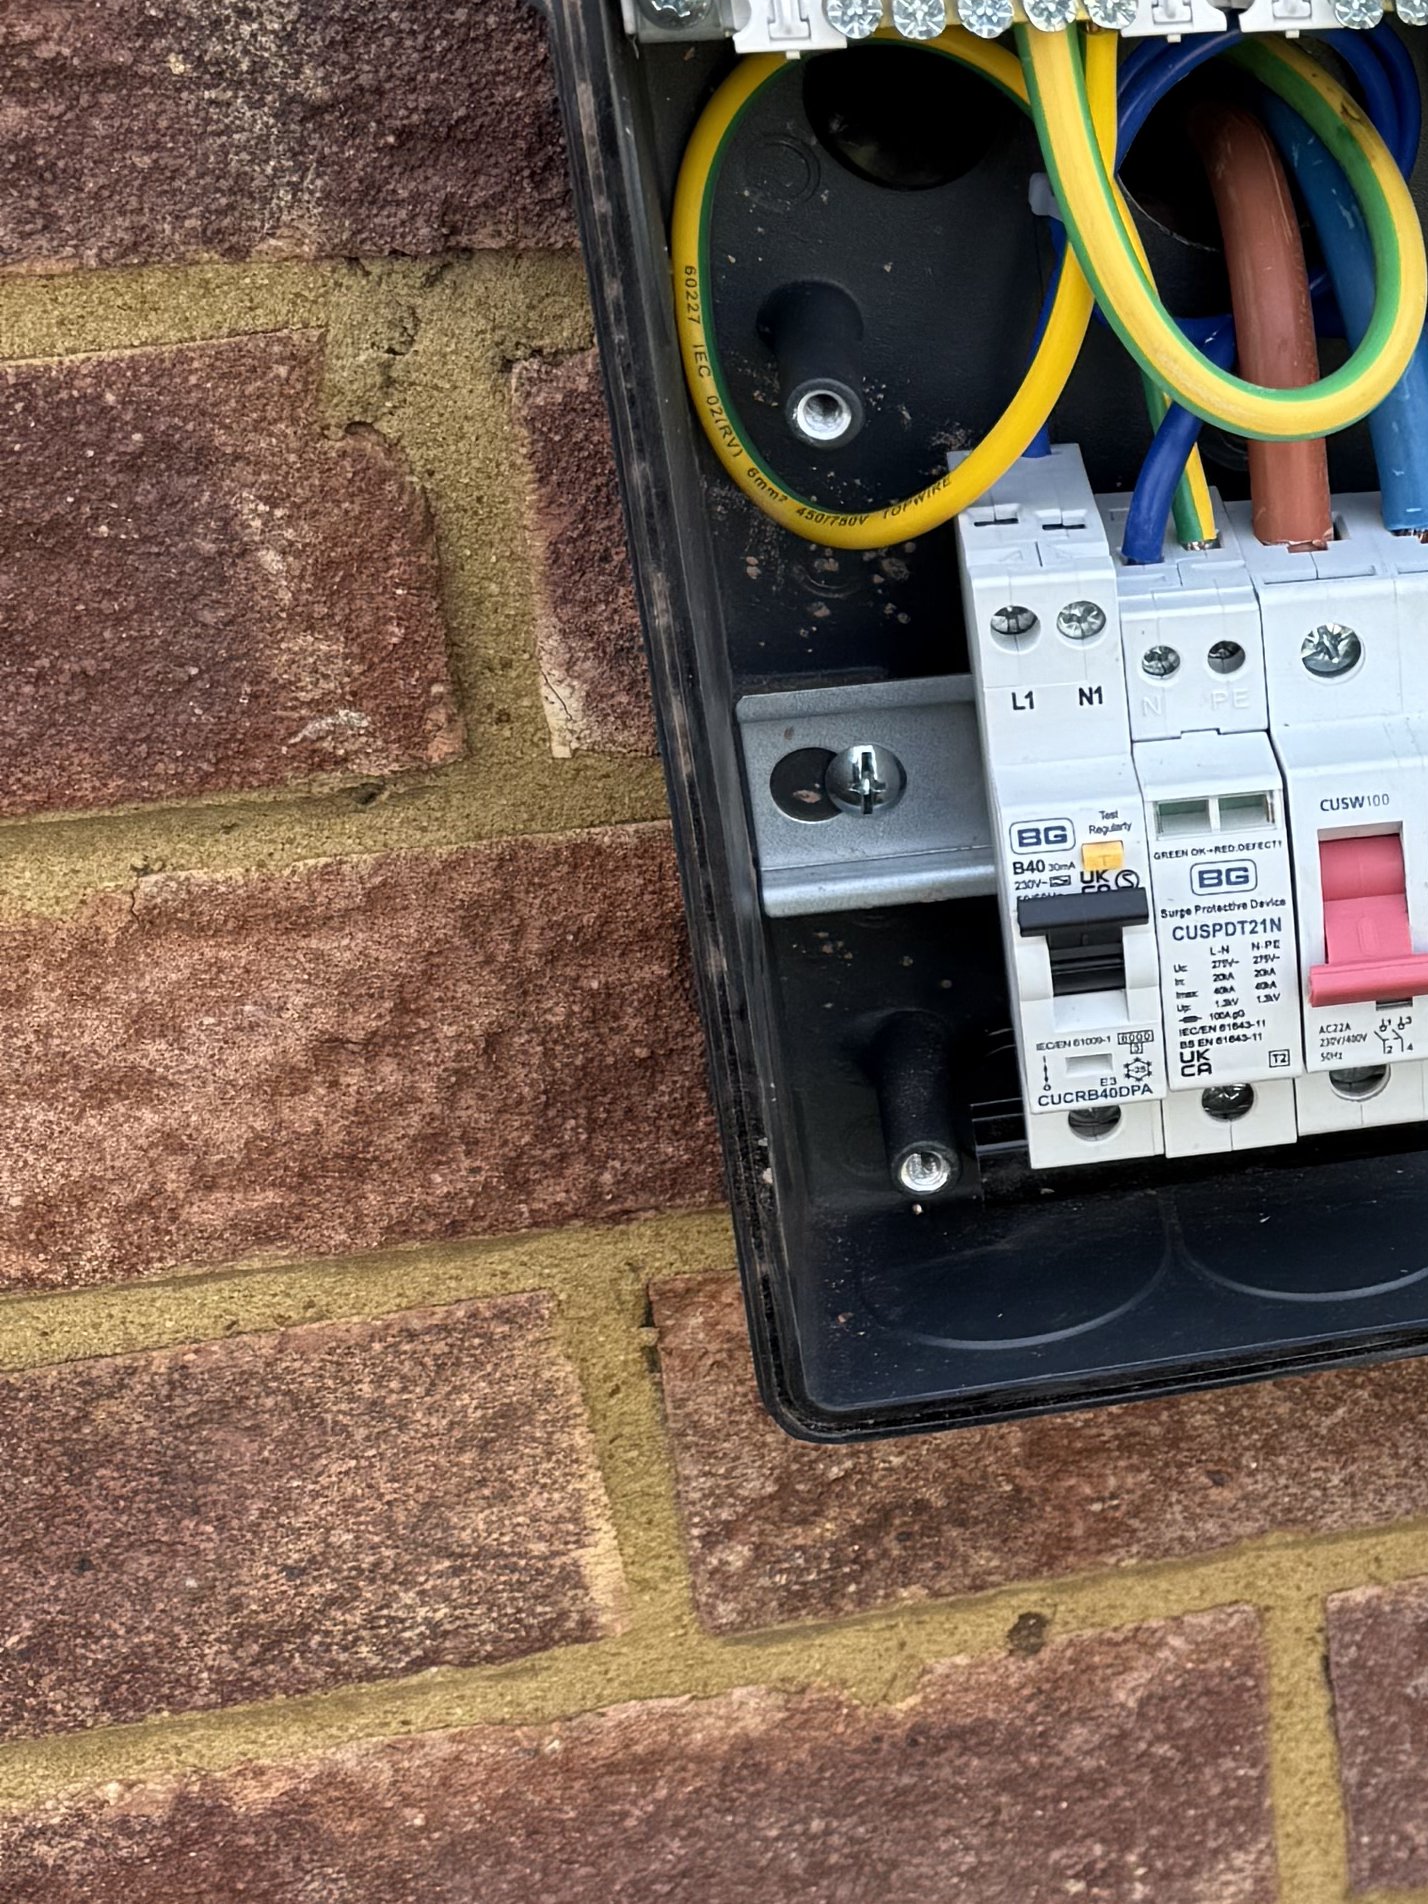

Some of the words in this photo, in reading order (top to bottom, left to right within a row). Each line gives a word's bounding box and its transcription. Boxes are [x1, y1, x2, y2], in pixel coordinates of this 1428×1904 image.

[684, 265, 701, 324] 60227
[692, 344, 711, 379] IEC
[706, 395, 744, 457] 02(RV)
[882, 476, 952, 520] TOPWIRE
[1011, 691, 1036, 711] L1
[1078, 685, 1105, 707] N1
[1141, 696, 1163, 718] N
[1211, 690, 1251, 711] PE
[1319, 793, 1390, 812] CUSW100
[1099, 809, 1119, 820] Test
[1017, 825, 1068, 847] BG
[1153, 849, 1189, 860] GREEN
[1013, 859, 1046, 875] B40
[1048, 861, 1077, 872] 30mA
[1198, 867, 1250, 888] BG
[1161, 907, 1192, 920] Surge
[1195, 901, 1248, 915] Protective
[1250, 898, 1287, 910] Device
[1172, 917, 1282, 941] CUSPDT21N
[1318, 1022, 1352, 1035] AC22A
[1197, 1037, 1214, 1047] EN
[1179, 1048, 1211, 1064] UK
[1272, 1053, 1287, 1065] T2
[1181, 1062, 1213, 1078] CA
[1037, 1083, 1154, 1107] CUCRB40DPA
